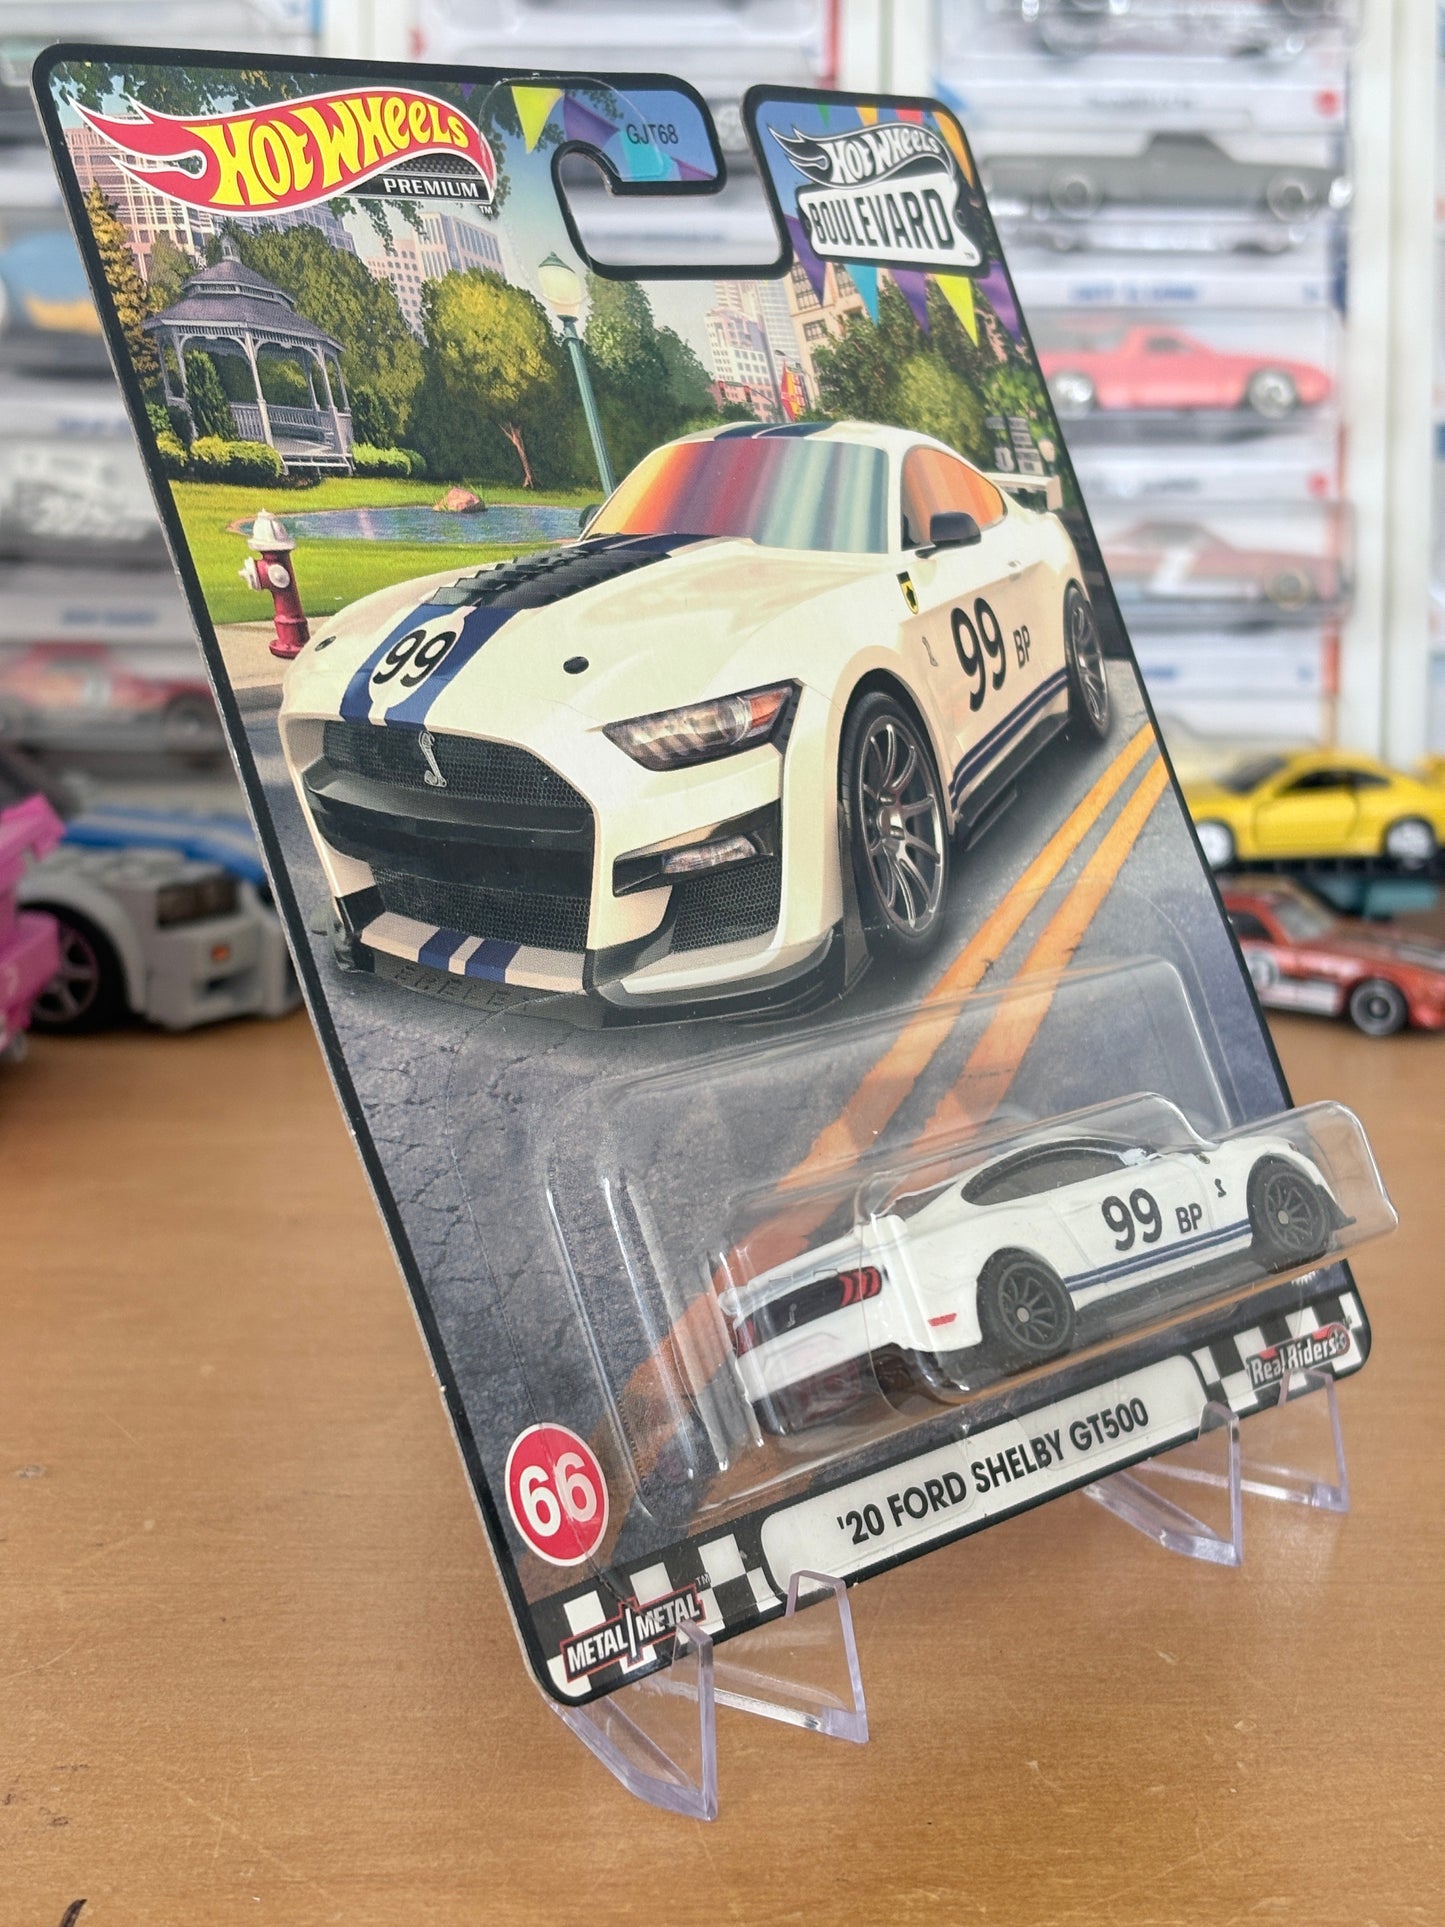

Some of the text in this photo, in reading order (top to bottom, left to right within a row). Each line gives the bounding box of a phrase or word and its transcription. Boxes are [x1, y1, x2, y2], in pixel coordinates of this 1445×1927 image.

[626, 123, 679, 145] GJT68
[382, 178, 480, 198] PREMIUM
[807, 188, 955, 250] BOULEVARD
[372, 629, 457, 688] 99
[950, 597, 1031, 712] 99 BP
[1101, 1188, 1203, 1251] 99 BP
[519, 1451, 598, 1538] 66
[836, 1397, 1149, 1545] '20 FORD SHELBY GT500
